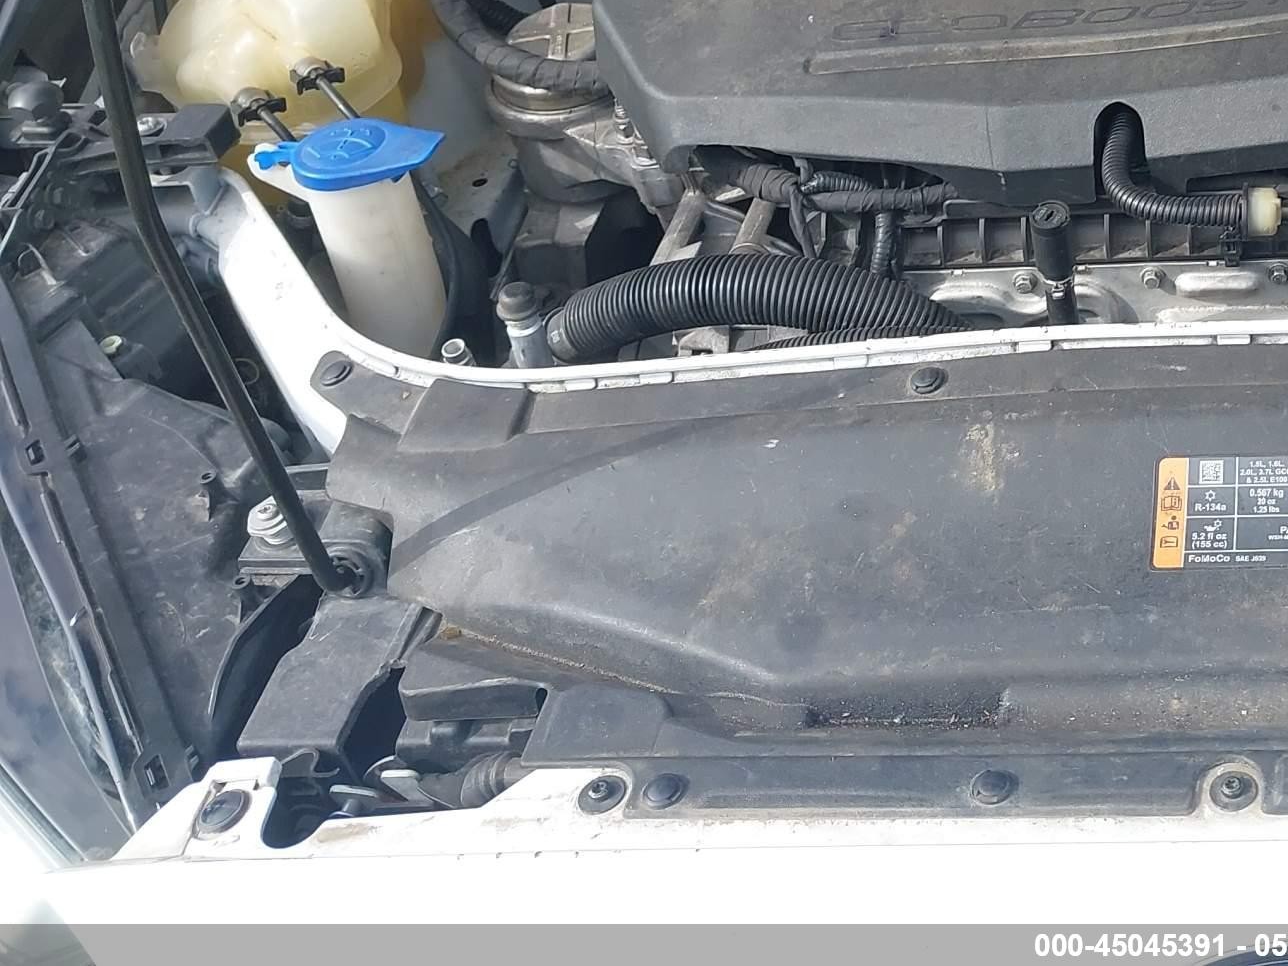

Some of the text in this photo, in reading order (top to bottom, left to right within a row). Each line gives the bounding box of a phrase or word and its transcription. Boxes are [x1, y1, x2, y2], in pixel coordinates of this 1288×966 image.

[1273, 488, 1284, 498] kg
[1194, 503, 1227, 511] R-134a
[1191, 532, 1206, 540] 5.2
[1207, 532, 1214, 540] fl
[1191, 540, 1228, 549] (155 cc)
[1188, 554, 1231, 563] FoMoCo
